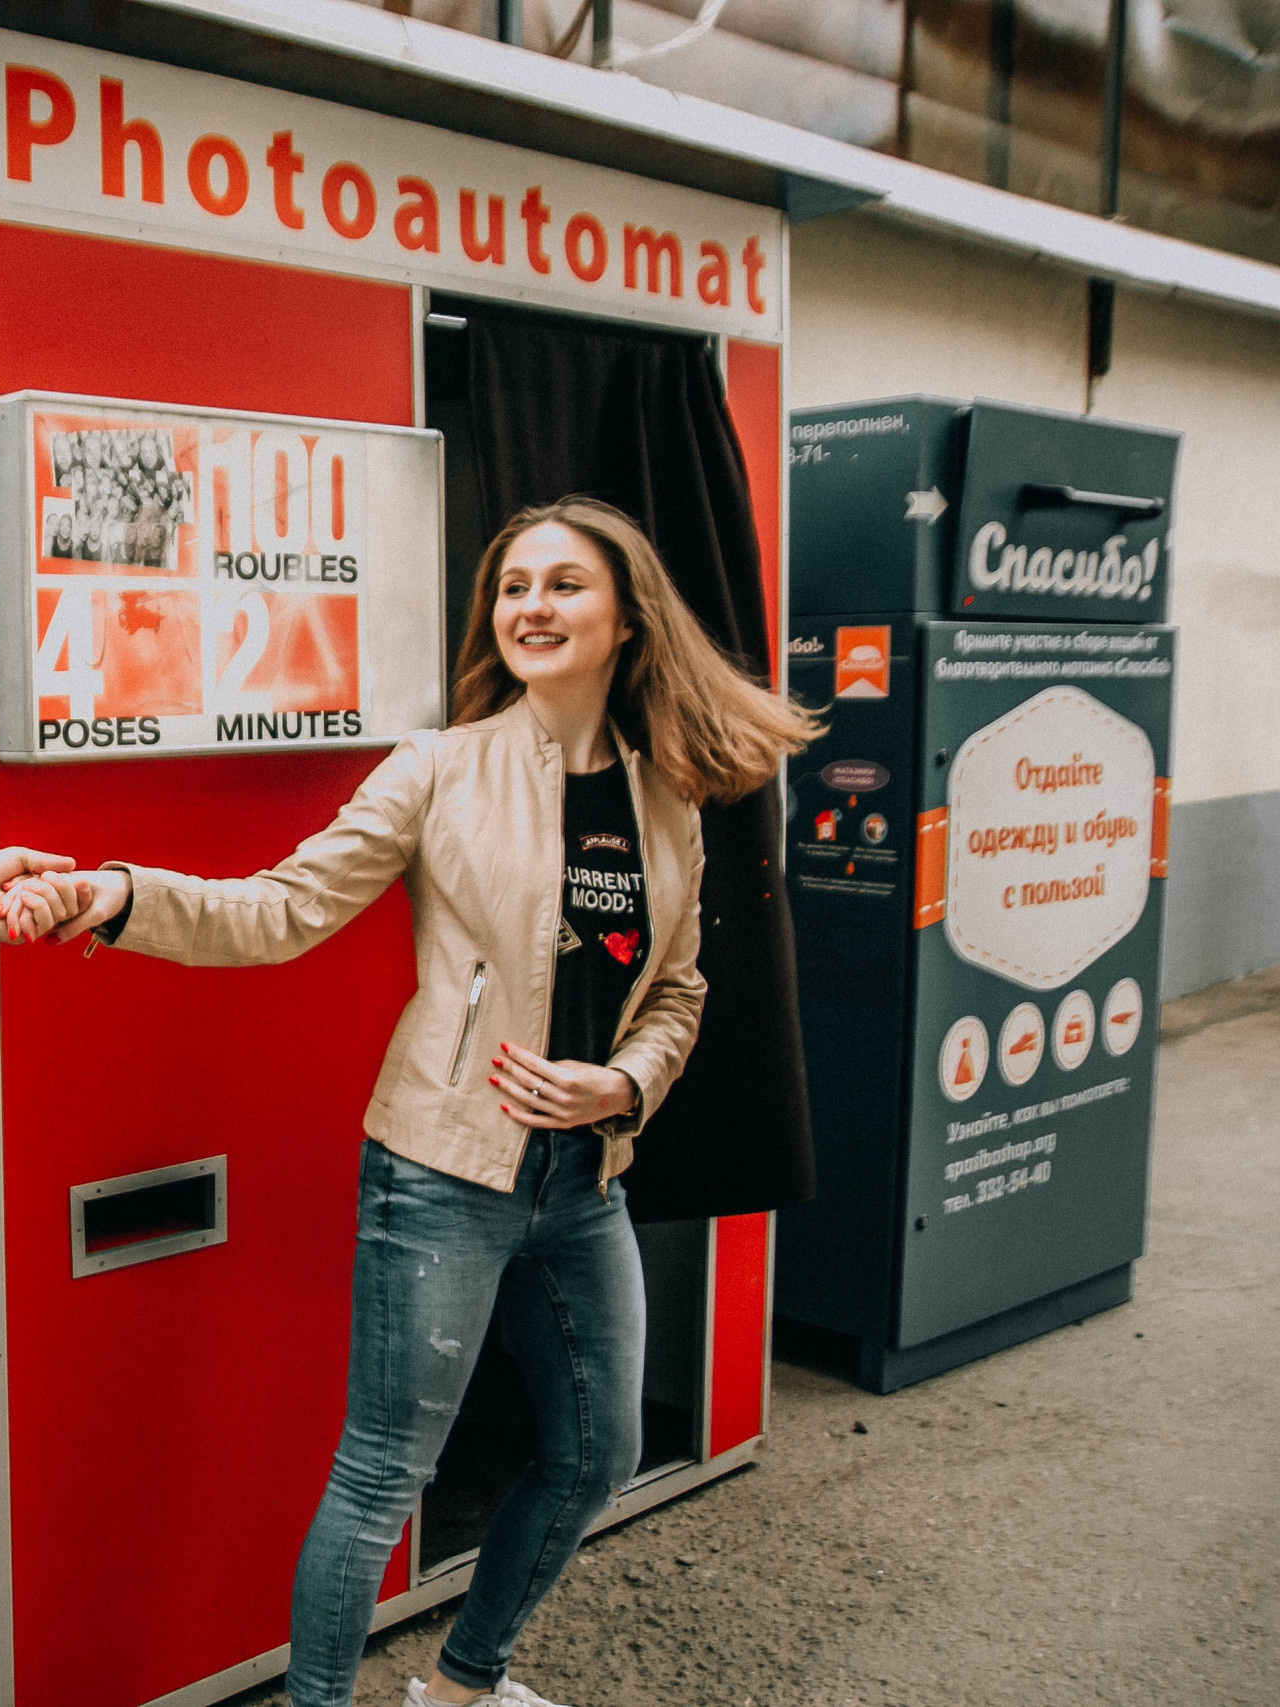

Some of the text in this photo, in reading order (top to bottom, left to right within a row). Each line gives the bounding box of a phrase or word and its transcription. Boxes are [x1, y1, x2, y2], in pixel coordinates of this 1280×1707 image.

[4, 62, 768, 315] Photoautomat
[211, 428, 363, 557] 100
[213, 551, 359, 583] ROUBLES
[970, 520, 1159, 603] Спасибо!
[37, 586, 104, 719] 4
[216, 590, 273, 714] 2
[38, 715, 162, 749] POSES
[216, 709, 363, 741] MINUTES
[1015, 752, 1104, 795] Отдайте
[969, 808, 1139, 860] одежду и обувь
[563, 865, 643, 892] URRENT
[1002, 862, 1106, 910] с пользой
